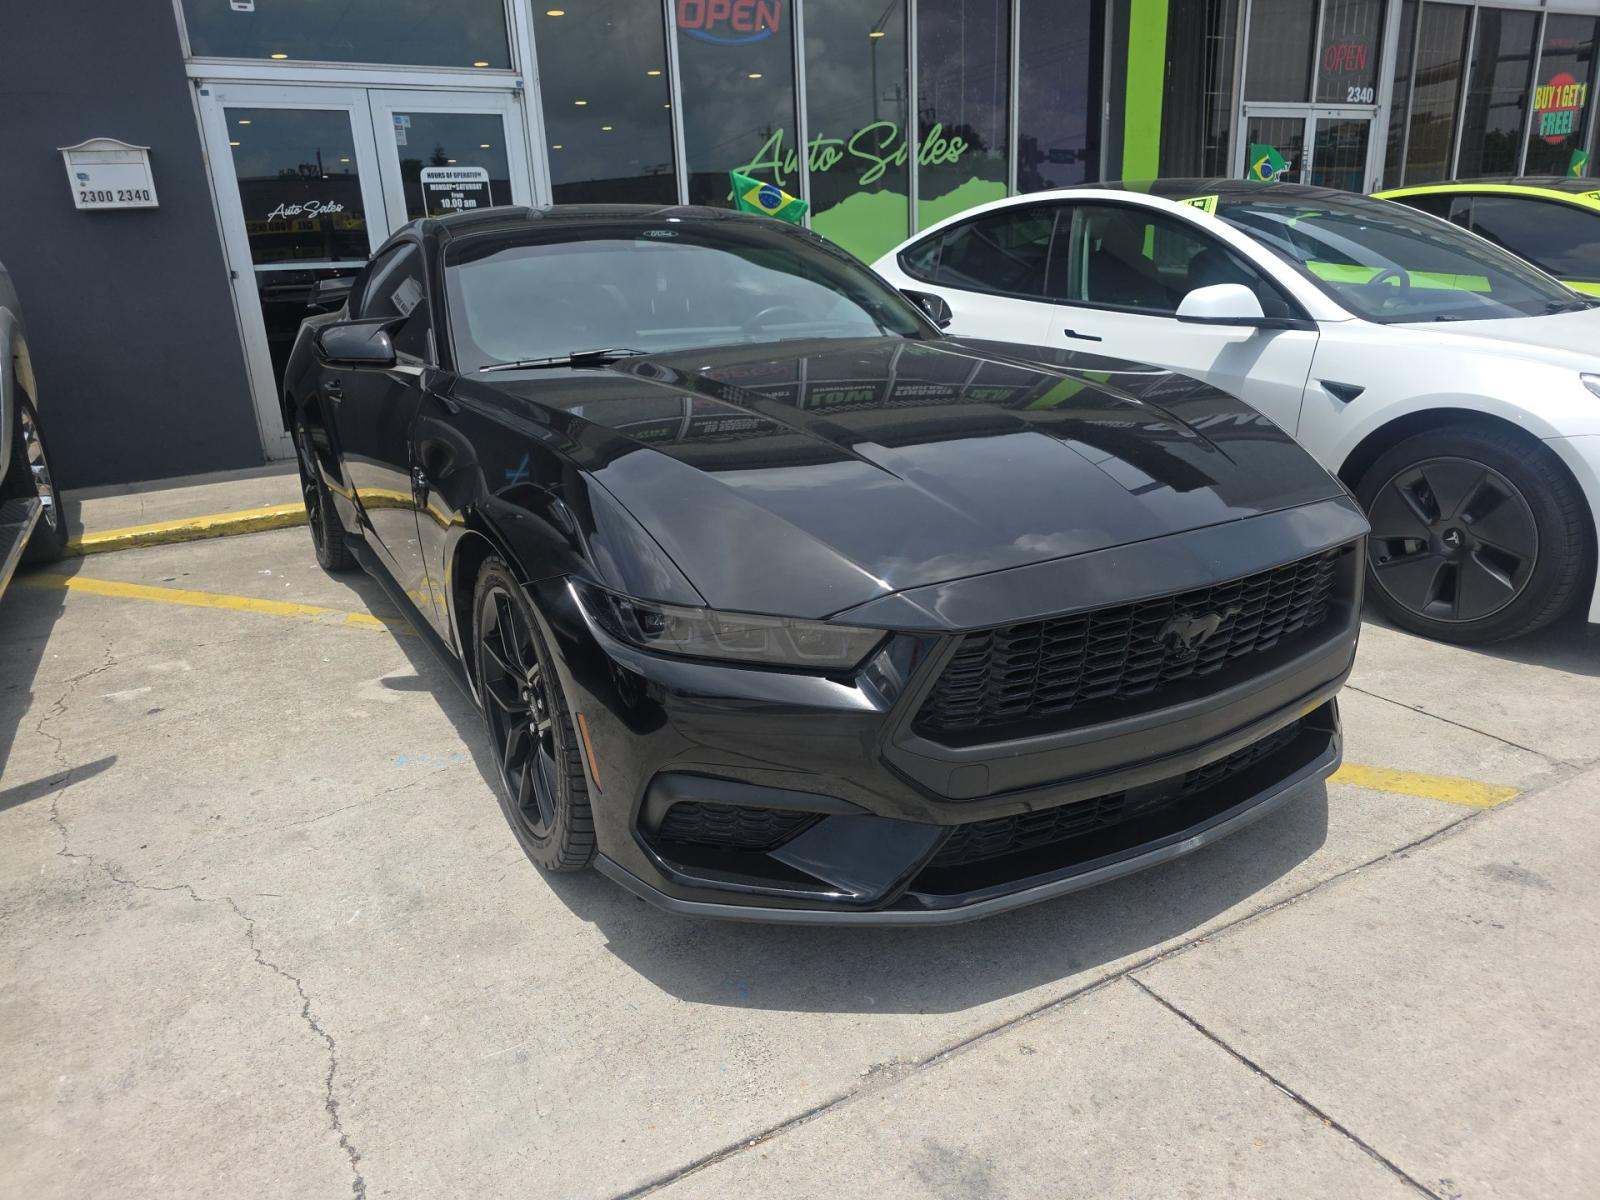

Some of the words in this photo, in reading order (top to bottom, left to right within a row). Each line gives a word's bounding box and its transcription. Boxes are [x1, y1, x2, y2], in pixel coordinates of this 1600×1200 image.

[677, 0, 782, 33] OPEN
[1324, 44, 1367, 71] OPEN
[1346, 86, 1374, 103] 2340
[1535, 86, 1555, 109] BUY
[1556, 86, 1562, 108] 1
[1562, 84, 1580, 107] GET
[1580, 83, 1587, 108] 1
[1540, 110, 1573, 136] FREE!
[728, 128, 844, 200] Auto
[849, 121, 968, 185] Sales
[80, 190, 113, 202] 2300
[117, 189, 150, 201] 2340
[464, 200, 477, 208] am
[267, 203, 302, 222] Auto
[303, 200, 344, 218] Sales
